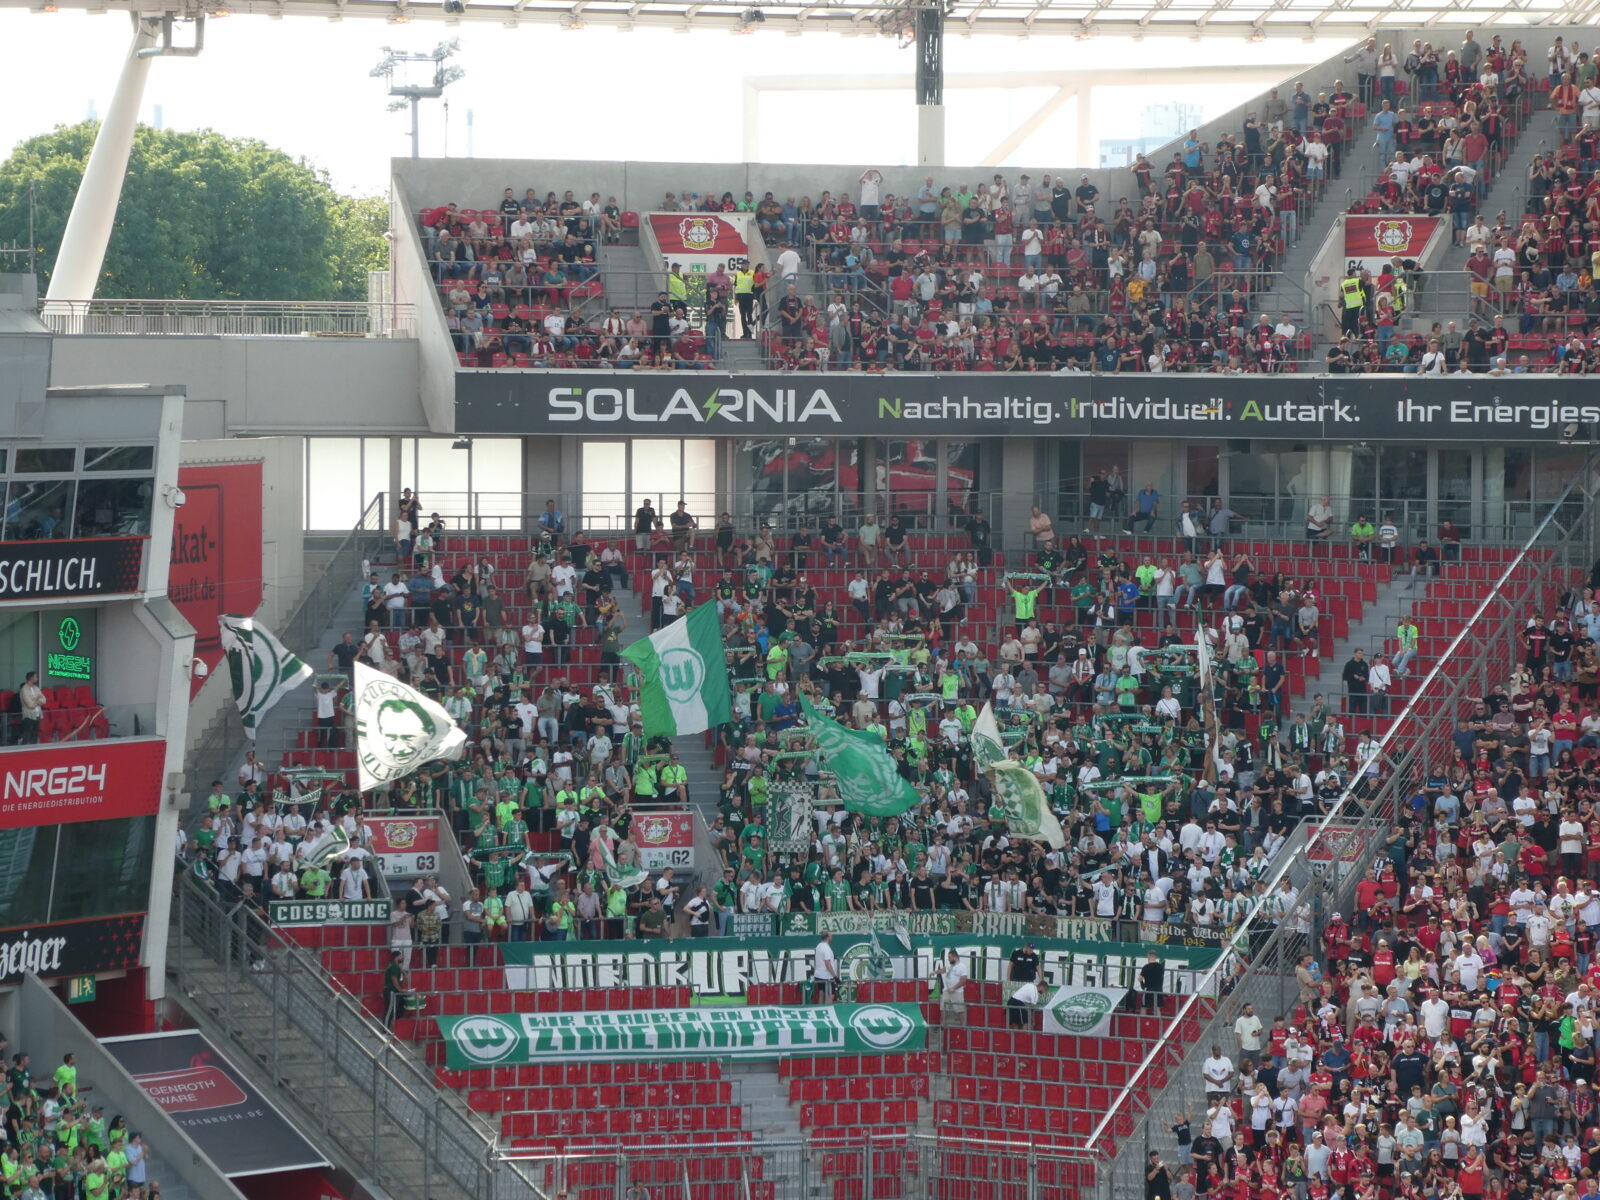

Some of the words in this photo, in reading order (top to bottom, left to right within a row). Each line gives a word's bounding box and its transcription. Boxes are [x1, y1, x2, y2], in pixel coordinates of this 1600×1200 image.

[548, 387, 843, 423] SOLARNIA
[878, 397, 1061, 425] Nachhaltig.
[1071, 397, 1232, 421] Individuell.
[1239, 399, 1361, 422] Autark.
[1397, 399, 1442, 422] Ihr
[4, 763, 106, 799] NRG24
[3, 803, 15, 812] DIE
[18, 796, 103, 811] ENERGIEDISTRIBUTION
[416, 855, 435, 871] G3
[672, 850, 690, 865] G2
[528, 1015, 576, 1027] WIR
[583, 1011, 700, 1026] GLAUBEN
[710, 1010, 742, 1021] AN
[750, 1009, 830, 1020] UNSER
[531, 1019, 839, 1051] ZINNENWAPPEN
